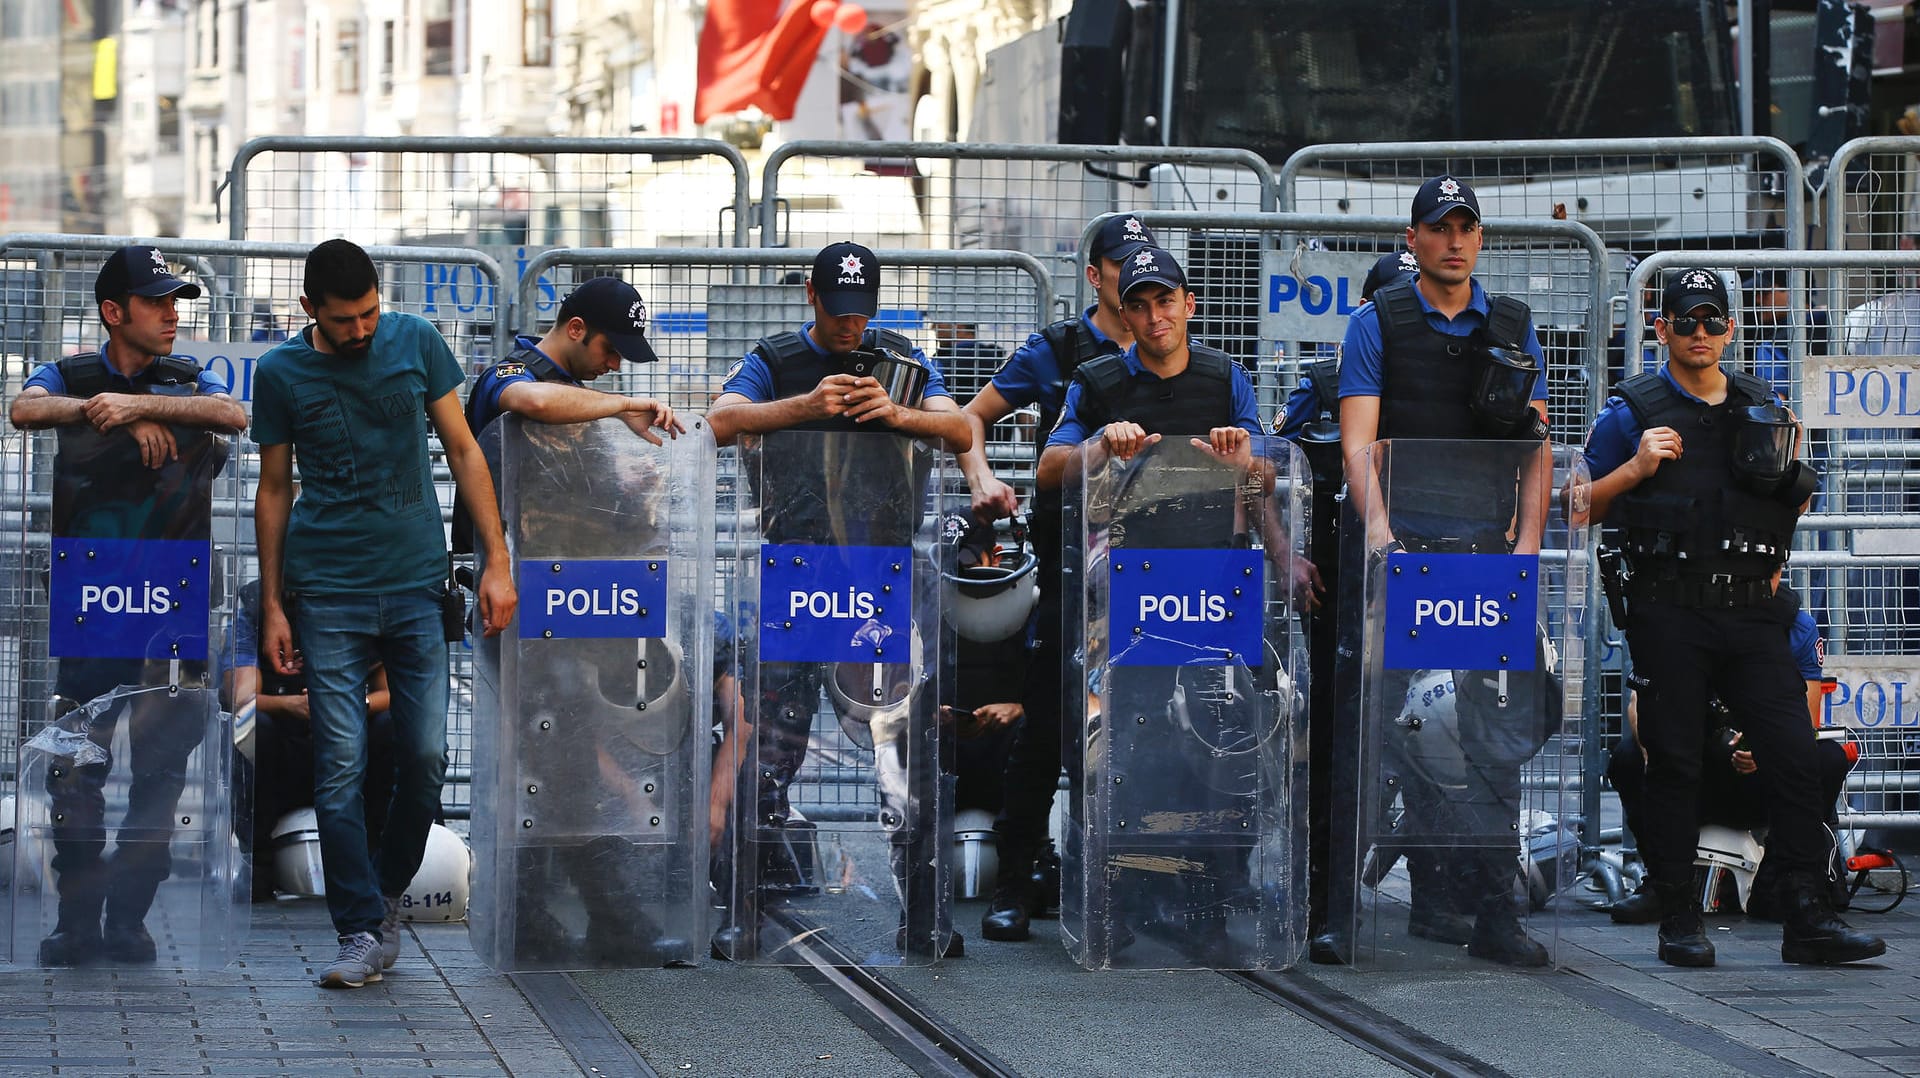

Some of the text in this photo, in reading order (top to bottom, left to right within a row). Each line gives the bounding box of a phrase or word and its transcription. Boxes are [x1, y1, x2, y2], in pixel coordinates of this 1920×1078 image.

[1437, 195, 1466, 203] POLİS
[838, 275, 866, 285] POLİS
[1132, 265, 1159, 277] POLİS
[1686, 282, 1713, 290] POLİS
[82, 580, 171, 614] POLİS
[546, 583, 639, 616] POLİS
[790, 586, 875, 619] POLİS
[1139, 589, 1226, 622] POLİS
[1415, 594, 1501, 627] POLİS
